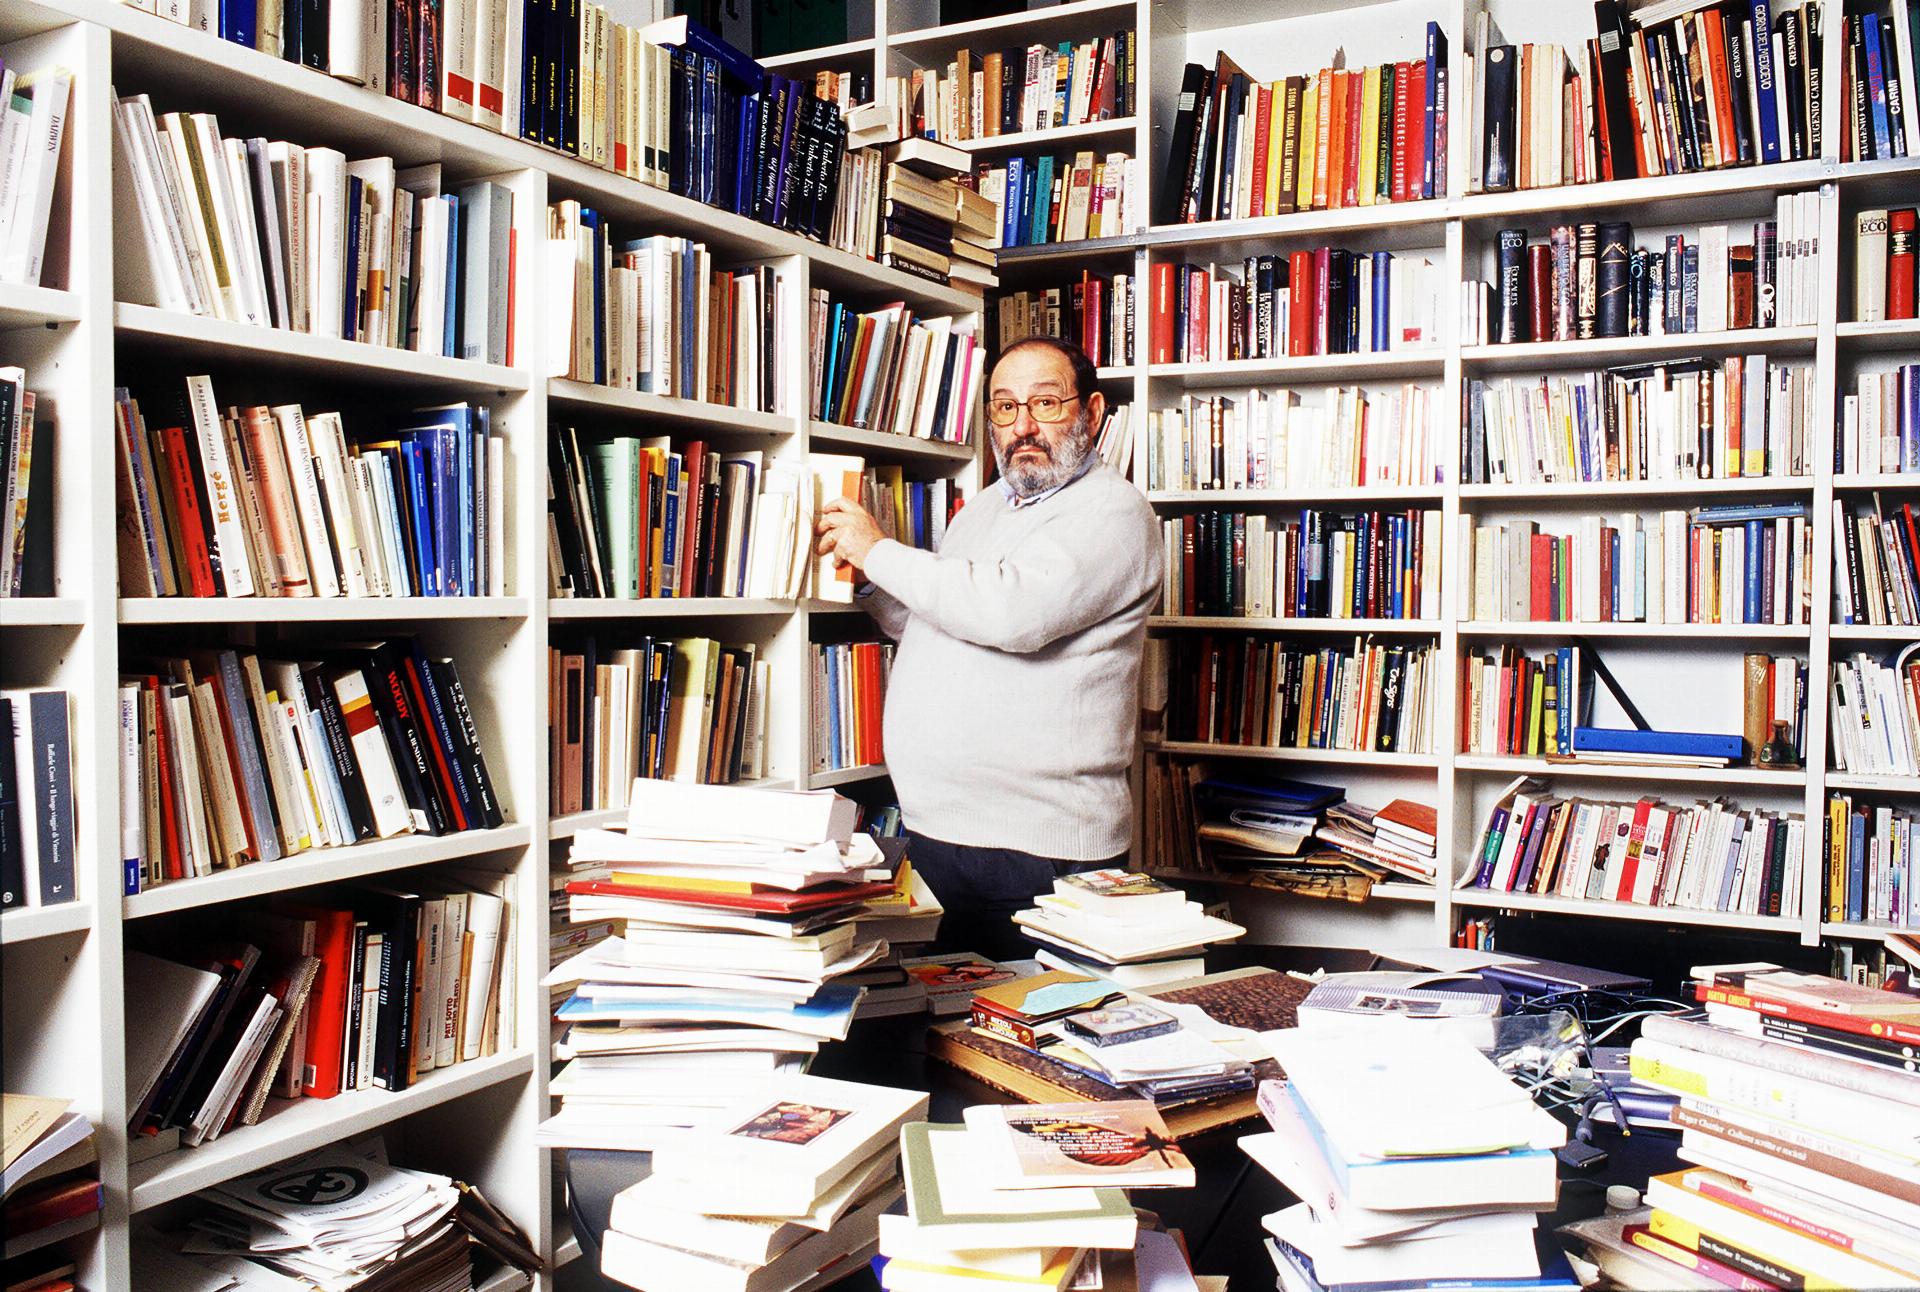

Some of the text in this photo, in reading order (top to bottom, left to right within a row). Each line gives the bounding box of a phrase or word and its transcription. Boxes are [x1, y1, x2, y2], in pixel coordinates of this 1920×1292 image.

[169, 2, 177, 16] dtv
[200, 15, 208, 30] dtv
[1753, 4, 1772, 89] GIORNI DEL MEDIOEVO
[1787, 16, 1797, 66] CREMONINI
[1730, 36, 1743, 77] CREMONINI
[1380, 93, 1388, 113] Picture
[1436, 82, 1444, 110] Arman
[1810, 68, 1820, 142] EUGENIO CARMI
[1888, 79, 1899, 114] CARMI
[1316, 76, 1331, 178] STORIA FIGURATA DELLE INVENZIONI
[1379, 116, 1387, 137] History
[1394, 67, 1407, 194] OPPFINNELSENES HISTORIE
[1856, 80, 1870, 154] EUGENIO CARMI
[48, 115, 61, 153] DARWIN
[1281, 87, 1298, 191] STORIA FIGURATA DELLE INVENZIONI
[767, 157, 778, 172] Eco
[784, 162, 795, 176] Eco
[801, 137, 819, 196] Umberto Eco
[818, 142, 833, 181] Umberto
[1008, 161, 1018, 181] ECO
[1378, 148, 1386, 183] Inventions
[764, 175, 776, 202] Umberto
[780, 176, 793, 207] Umberto
[814, 182, 827, 200] Eco
[1860, 222, 1886, 233] ECO
[1502, 238, 1522, 250] ECO
[1561, 244, 1571, 304] UMBERTO ECO
[1245, 281, 1254, 304] ECO
[12, 416, 20, 440] CESARE
[196, 383, 217, 460] Pierre Assouline
[8, 441, 18, 471] MILANESE
[209, 470, 233, 523] Hergé
[387, 670, 409, 718] WOODY
[1384, 682, 1397, 708] Signs
[1473, 690, 1482, 706] Films
[327, 705, 338, 723] DUCA
[336, 733, 354, 776] SANT'AQUILA
[1470, 720, 1480, 747] Semiotik
[46, 743, 55, 765] Raffaele
[327, 725, 340, 751] GIOVINEZZA
[337, 759, 347, 776] GADDA
[409, 736, 426, 774] BENDAZZI
[48, 767, 56, 782] Crovi
[49, 794, 57, 810] lungo
[50, 811, 58, 831] viaggio
[51, 838, 59, 862] Vittorini
[1770, 893, 1778, 905] ECO
[988, 1024, 1018, 1040] LAROUSSE
[990, 1016, 1012, 1030] RIZZOLI
[348, 1061, 356, 1086] GARZANTI
[1696, 1101, 1720, 1117] AUSTIN
[1679, 1112, 1698, 1125] Roger
[1699, 1118, 1724, 1134] Chartier
[1728, 1127, 1752, 1144] Cultura
[1754, 1136, 1776, 1151] scritta
[1782, 1146, 1807, 1160] società
